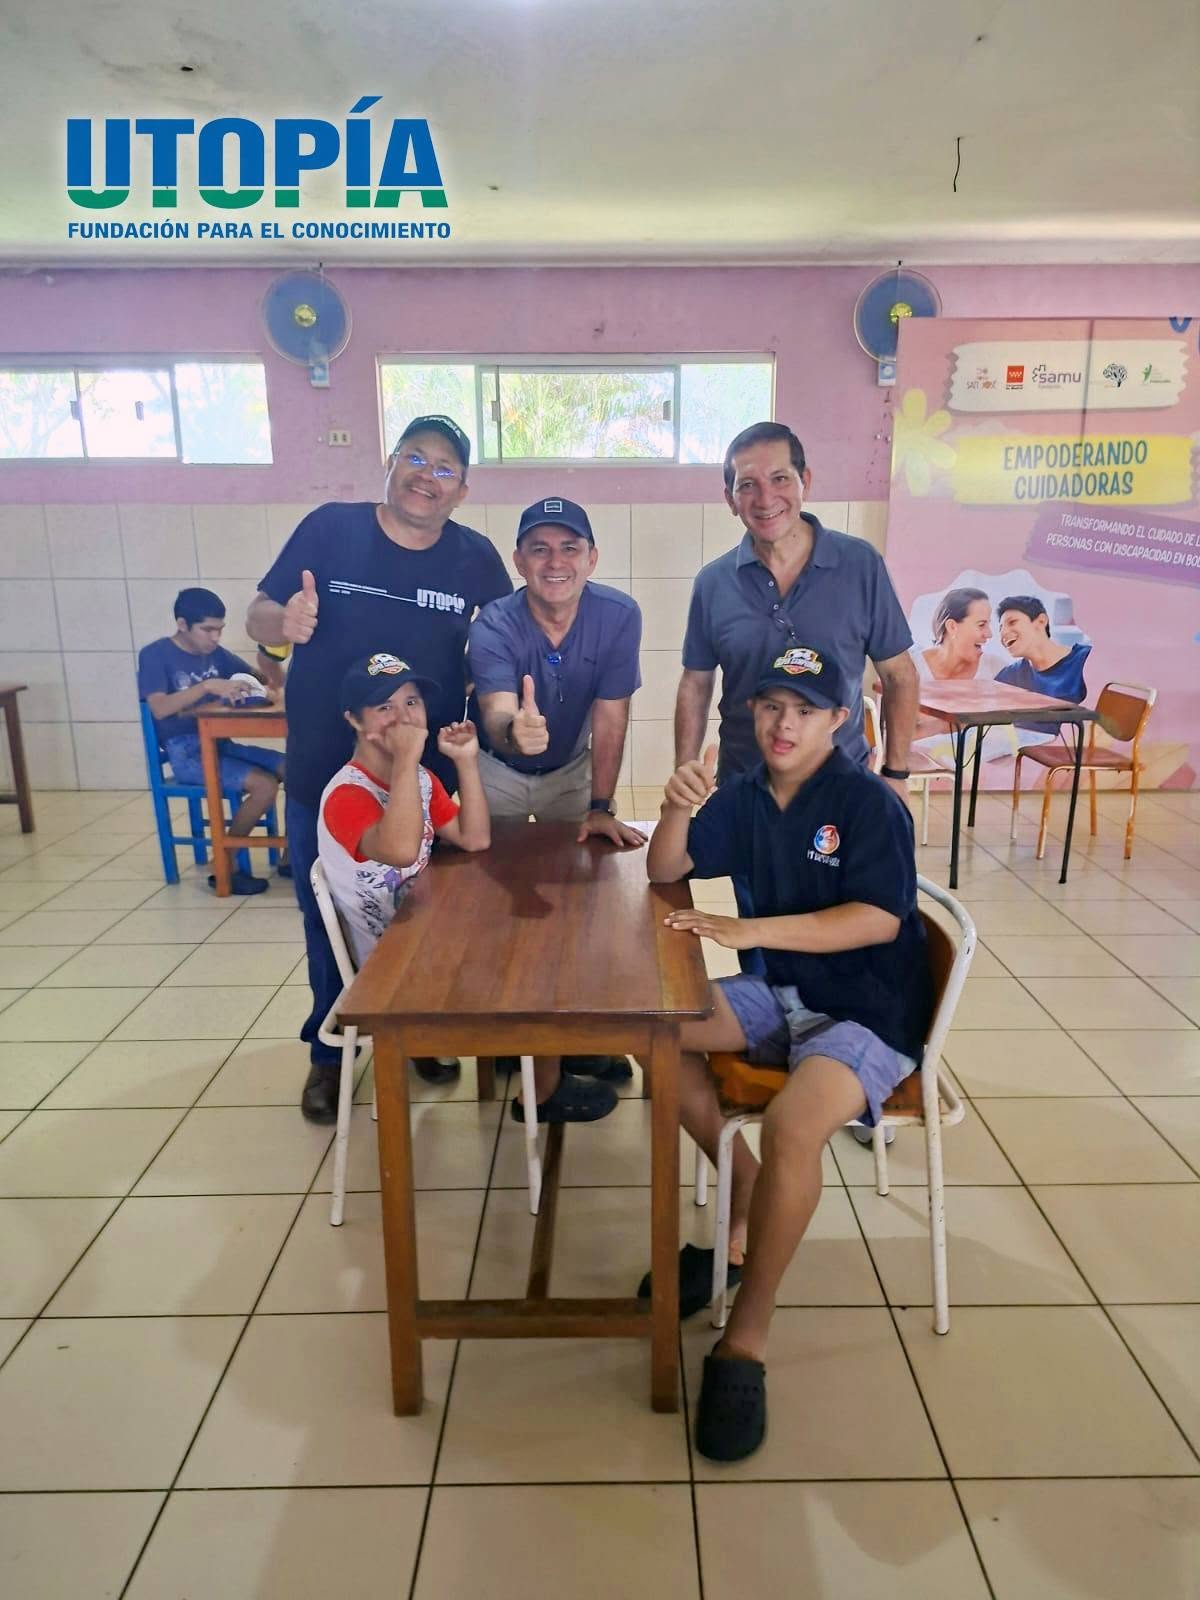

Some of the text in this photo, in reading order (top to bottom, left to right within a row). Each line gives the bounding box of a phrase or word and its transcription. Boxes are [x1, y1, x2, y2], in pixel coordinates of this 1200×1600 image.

[1039, 371, 1082, 384] samu
[1004, 440, 1148, 470] EMPODERANDO
[1014, 471, 1134, 500] CUIDADORAS
[1061, 514, 1135, 536] TRANSFORMANDO
[1136, 525, 1145, 538] EL
[1147, 527, 1183, 544] CUIDADO
[1183, 532, 1196, 546] DE
[1046, 532, 1093, 551] PERSONAS
[1094, 540, 1113, 554] CON
[1112, 543, 1173, 563] DISCAPACIDAD
[1173, 552, 1186, 564] EN
